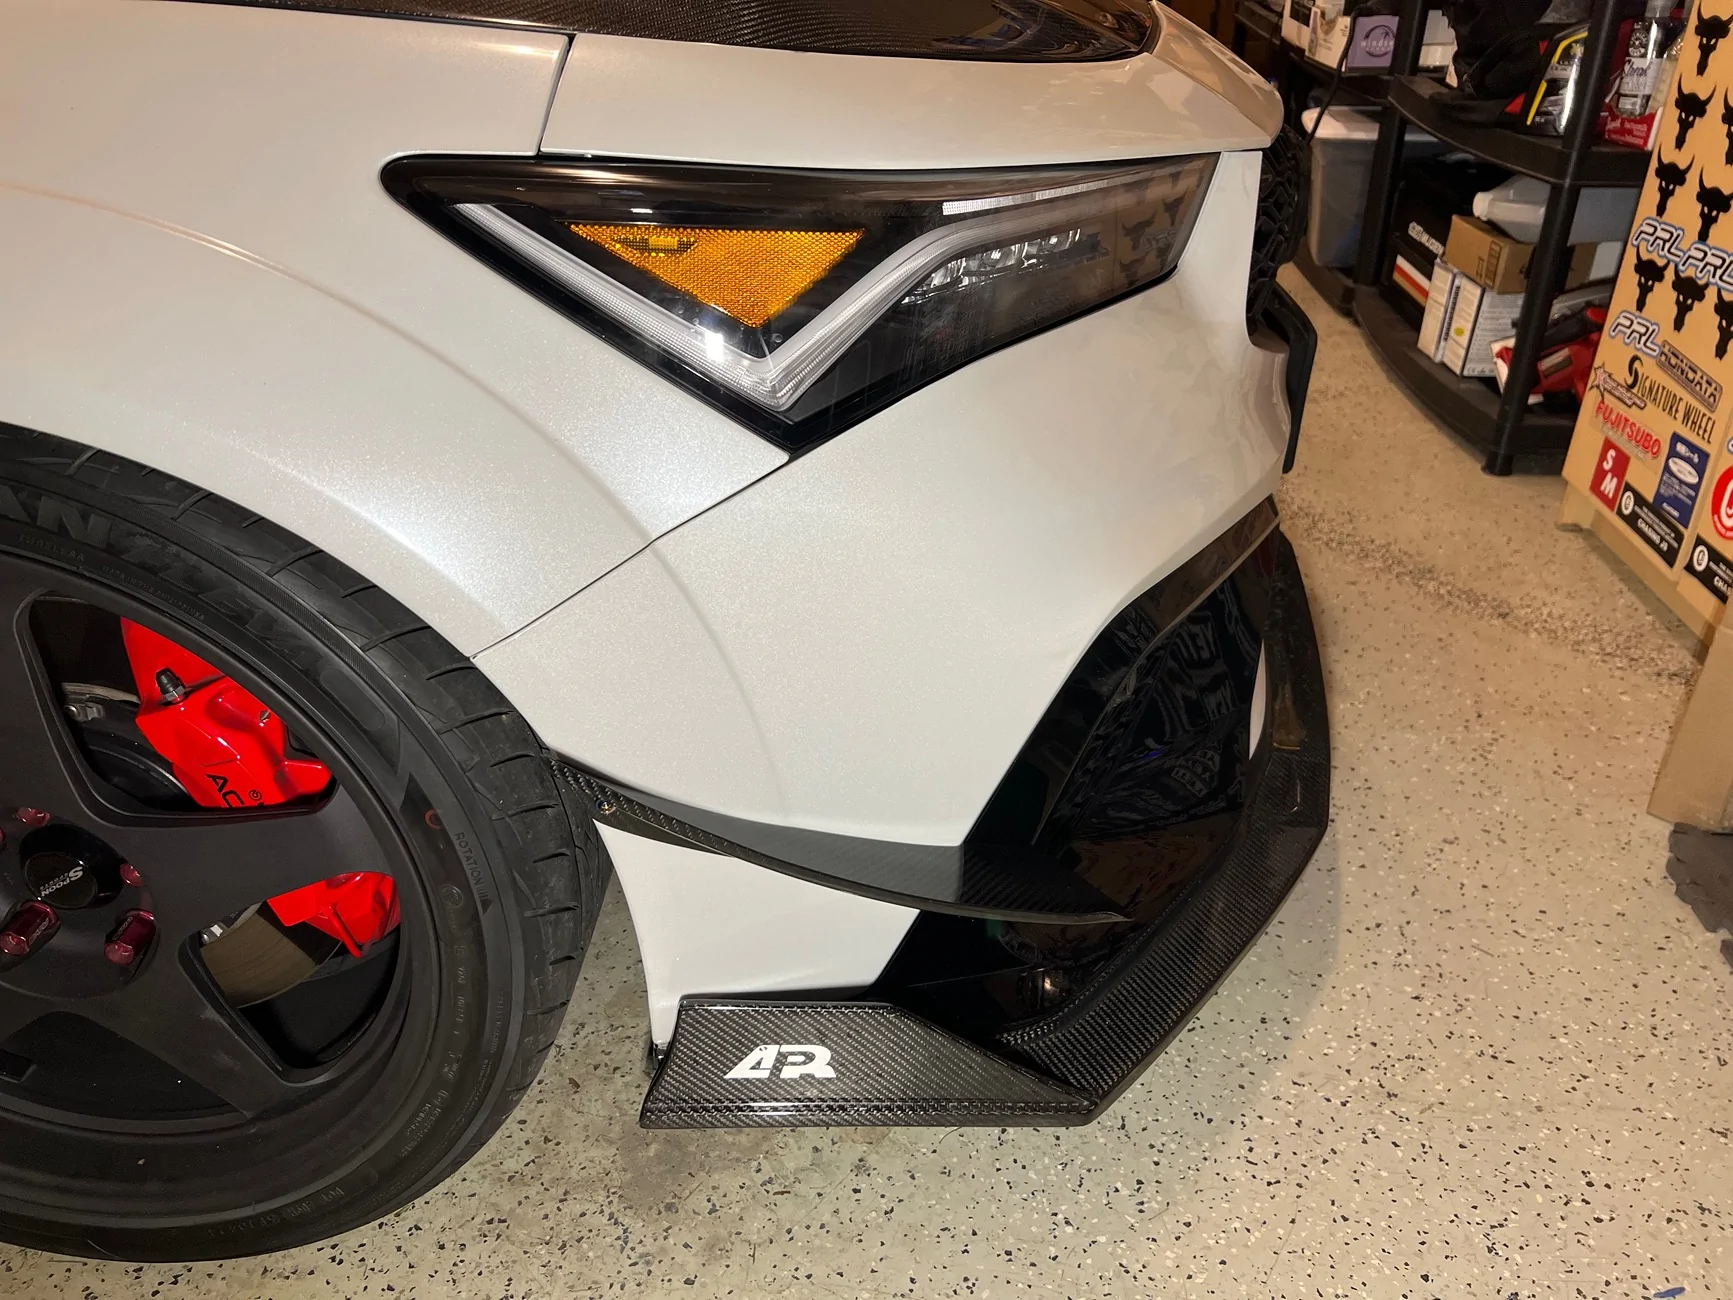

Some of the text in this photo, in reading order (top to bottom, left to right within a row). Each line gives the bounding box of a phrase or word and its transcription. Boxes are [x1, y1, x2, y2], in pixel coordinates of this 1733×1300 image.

[1631, 216, 1685, 263] PRL
[1608, 310, 1660, 359] PRL
[1660, 343, 1719, 401] HONDATA
[1595, 401, 1662, 459] FUJITSUBO
[1682, 400, 1717, 445] WHEEL
[1602, 448, 1616, 471] S
[1601, 472, 1618, 499] M
[41, 866, 84, 897] SPOON
[453, 831, 485, 888] ROTATION
